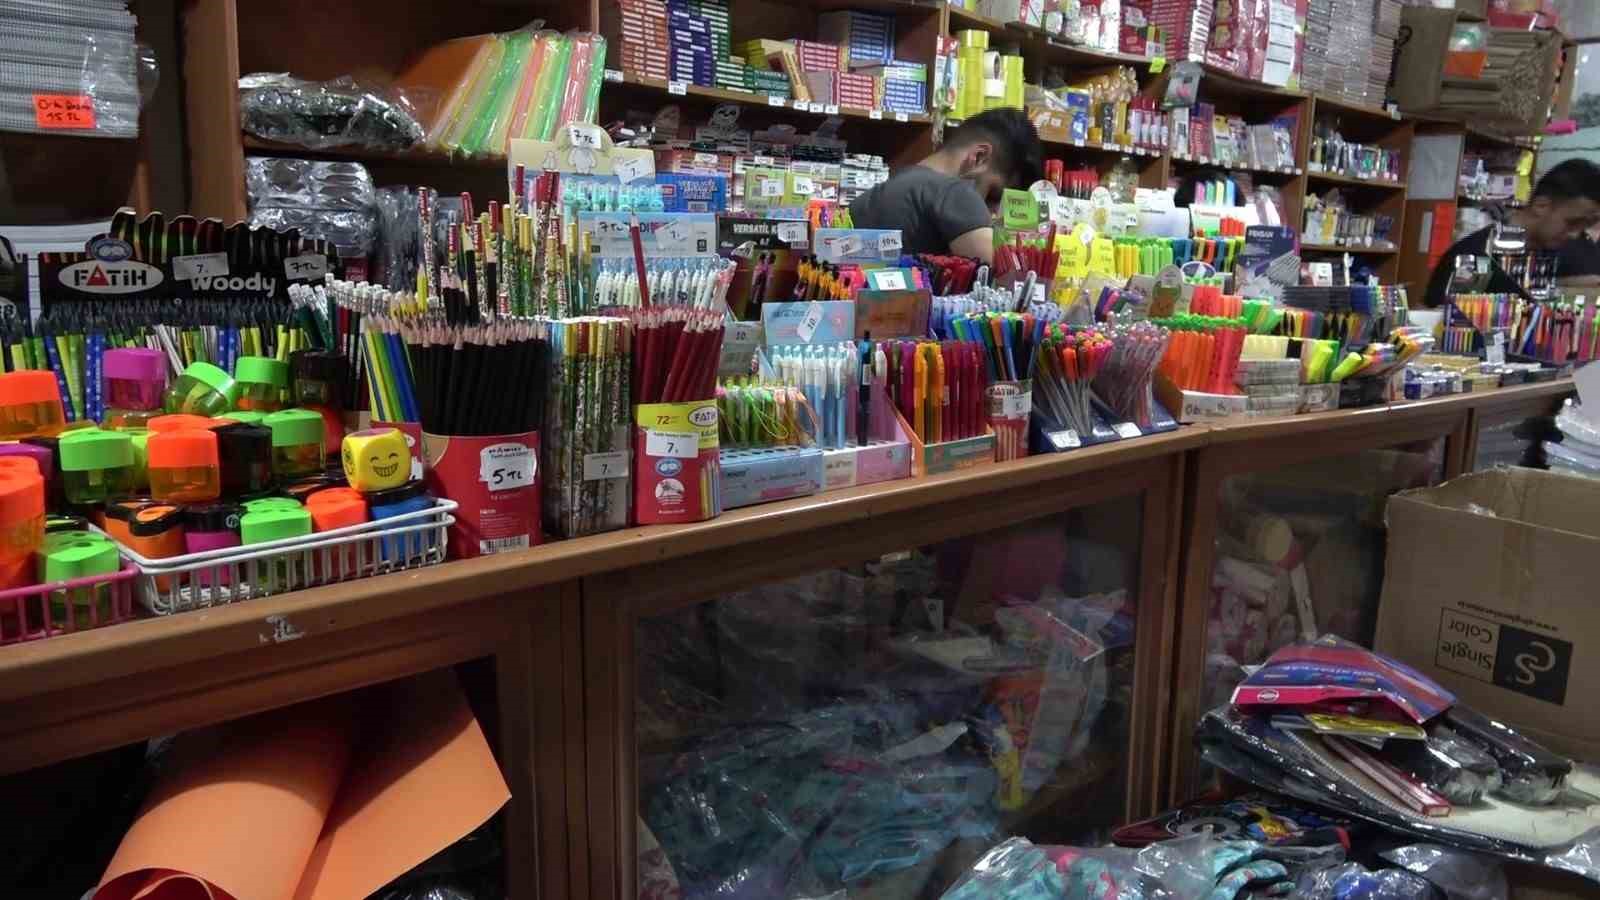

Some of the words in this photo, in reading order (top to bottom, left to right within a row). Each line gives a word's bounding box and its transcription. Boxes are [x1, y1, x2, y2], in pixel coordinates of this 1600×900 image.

[191, 272, 277, 297] Woody
[492, 468, 506, 484] 5
[1448, 618, 1493, 644] Color
[1441, 641, 1493, 671] Single
